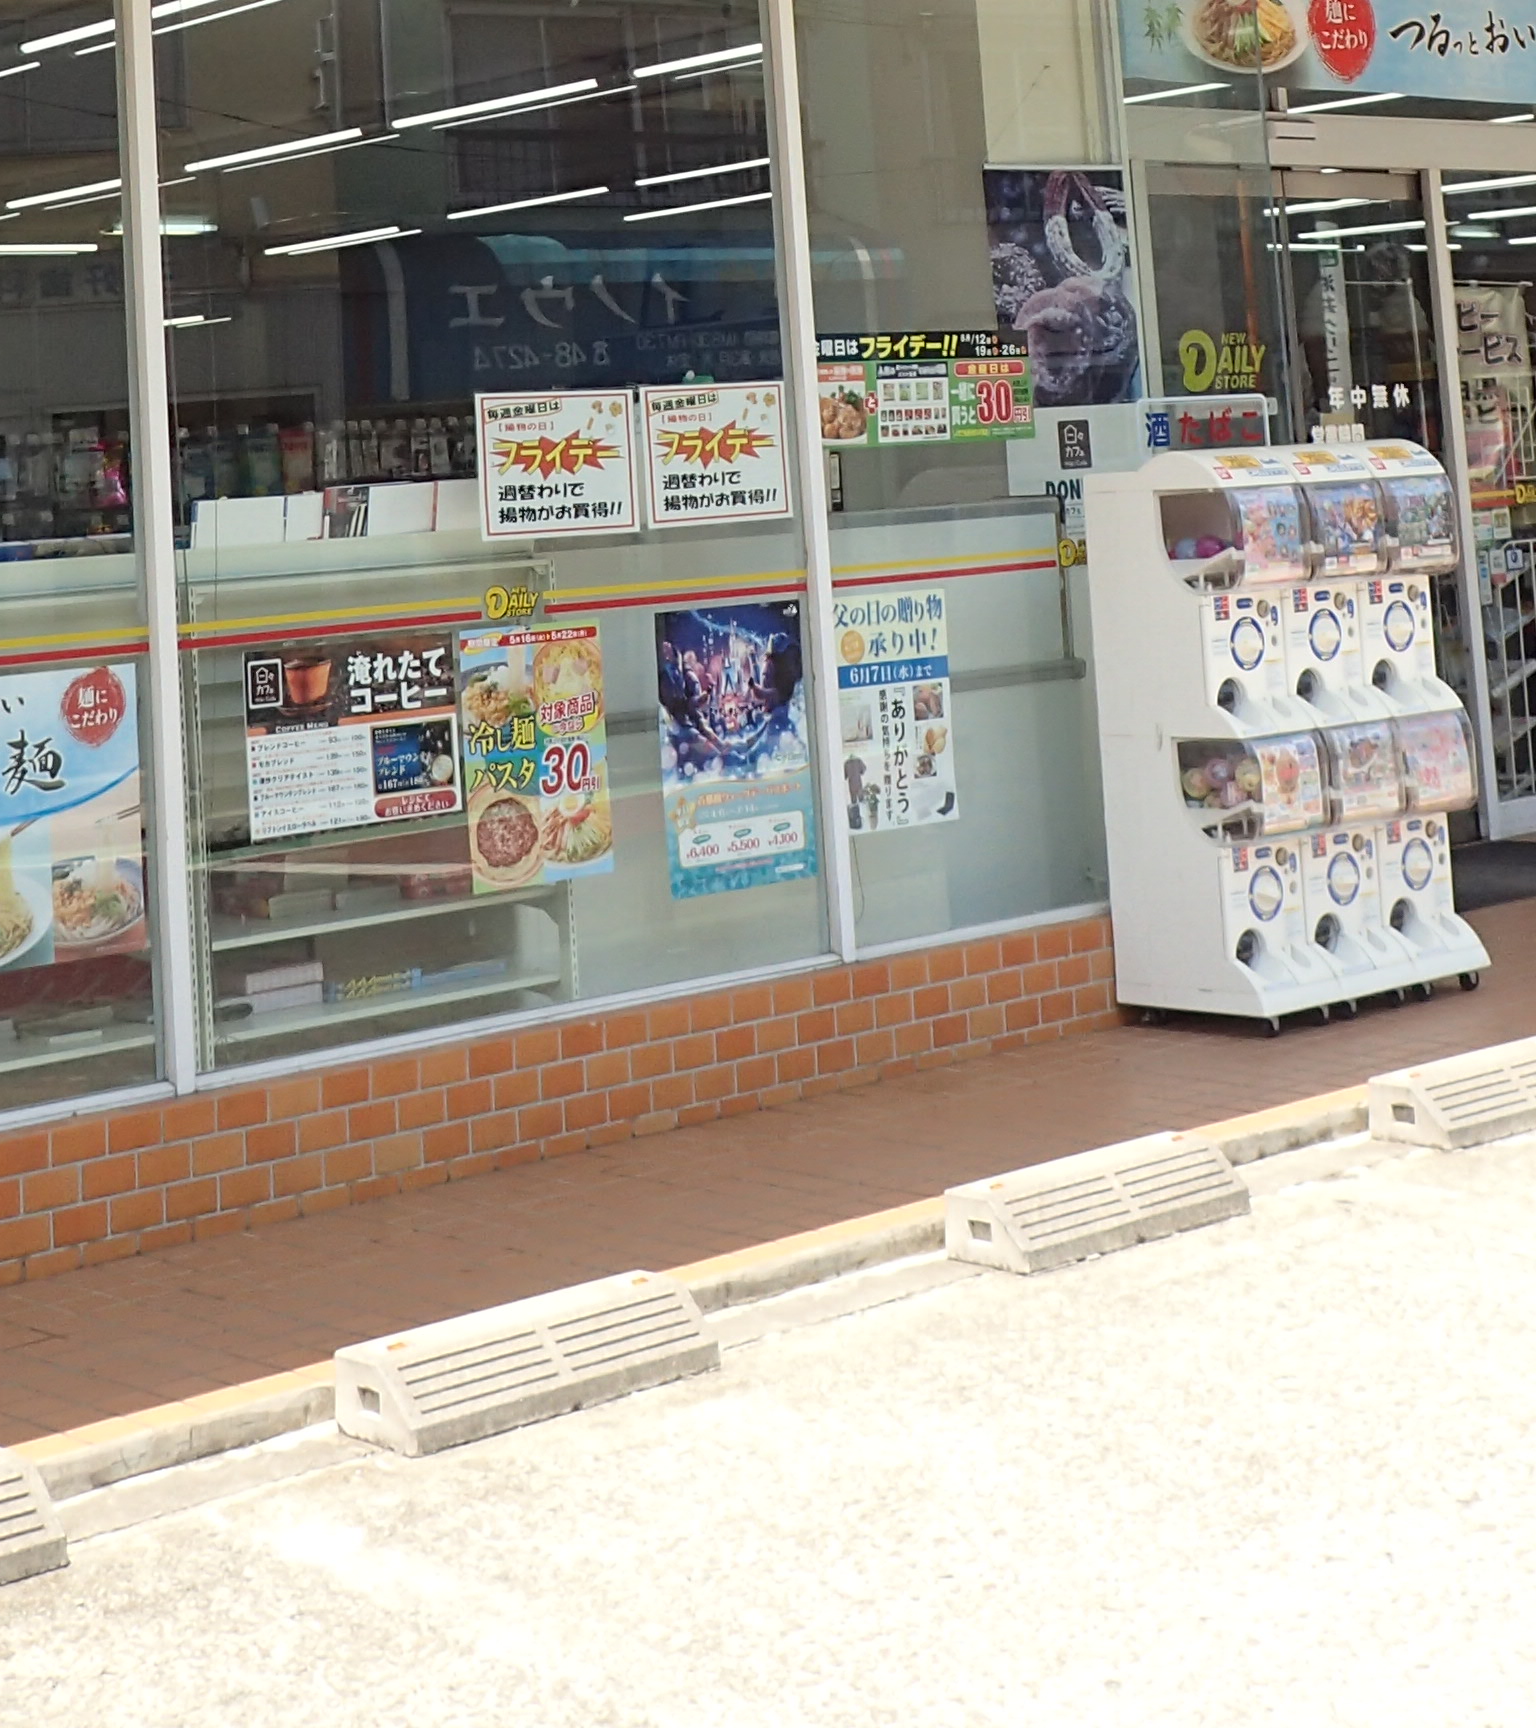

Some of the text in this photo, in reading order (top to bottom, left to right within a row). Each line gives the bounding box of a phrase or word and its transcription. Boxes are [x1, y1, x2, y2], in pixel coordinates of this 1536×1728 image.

[1321, 28, 1371, 51] こだわり
[1221, 332, 1247, 345] NEW
[1178, 329, 1266, 393] DAILY
[1215, 374, 1257, 390] STORE
[651, 391, 717, 412] 毎週金曜日は
[1328, 383, 1411, 410] 年中無休
[487, 400, 560, 421] 毎週金曜日は
[1145, 406, 1262, 448] 酒 たばこ
[492, 436, 621, 475] フライデー
[657, 428, 774, 466] フライデー
[1065, 446, 1085, 458] カフェ
[498, 482, 585, 502] 週替わりで
[662, 470, 742, 490] 週替わりで
[1045, 478, 1084, 501] DON
[485, 585, 539, 619] DAILY
[507, 608, 533, 617] STORE
[834, 594, 943, 629] 父の日の贈り物
[868, 627, 937, 658] 承り中!
[347, 647, 446, 686] 淹れたて
[849, 663, 933, 685] 6月7日(水)まで
[76, 684, 109, 708] 麺に
[350, 682, 447, 713] コーヒー
[540, 693, 593, 722] 対象商品
[71, 708, 119, 730] こだわり
[468, 715, 536, 756] 冷し麺
[469, 756, 536, 793] パスタ
